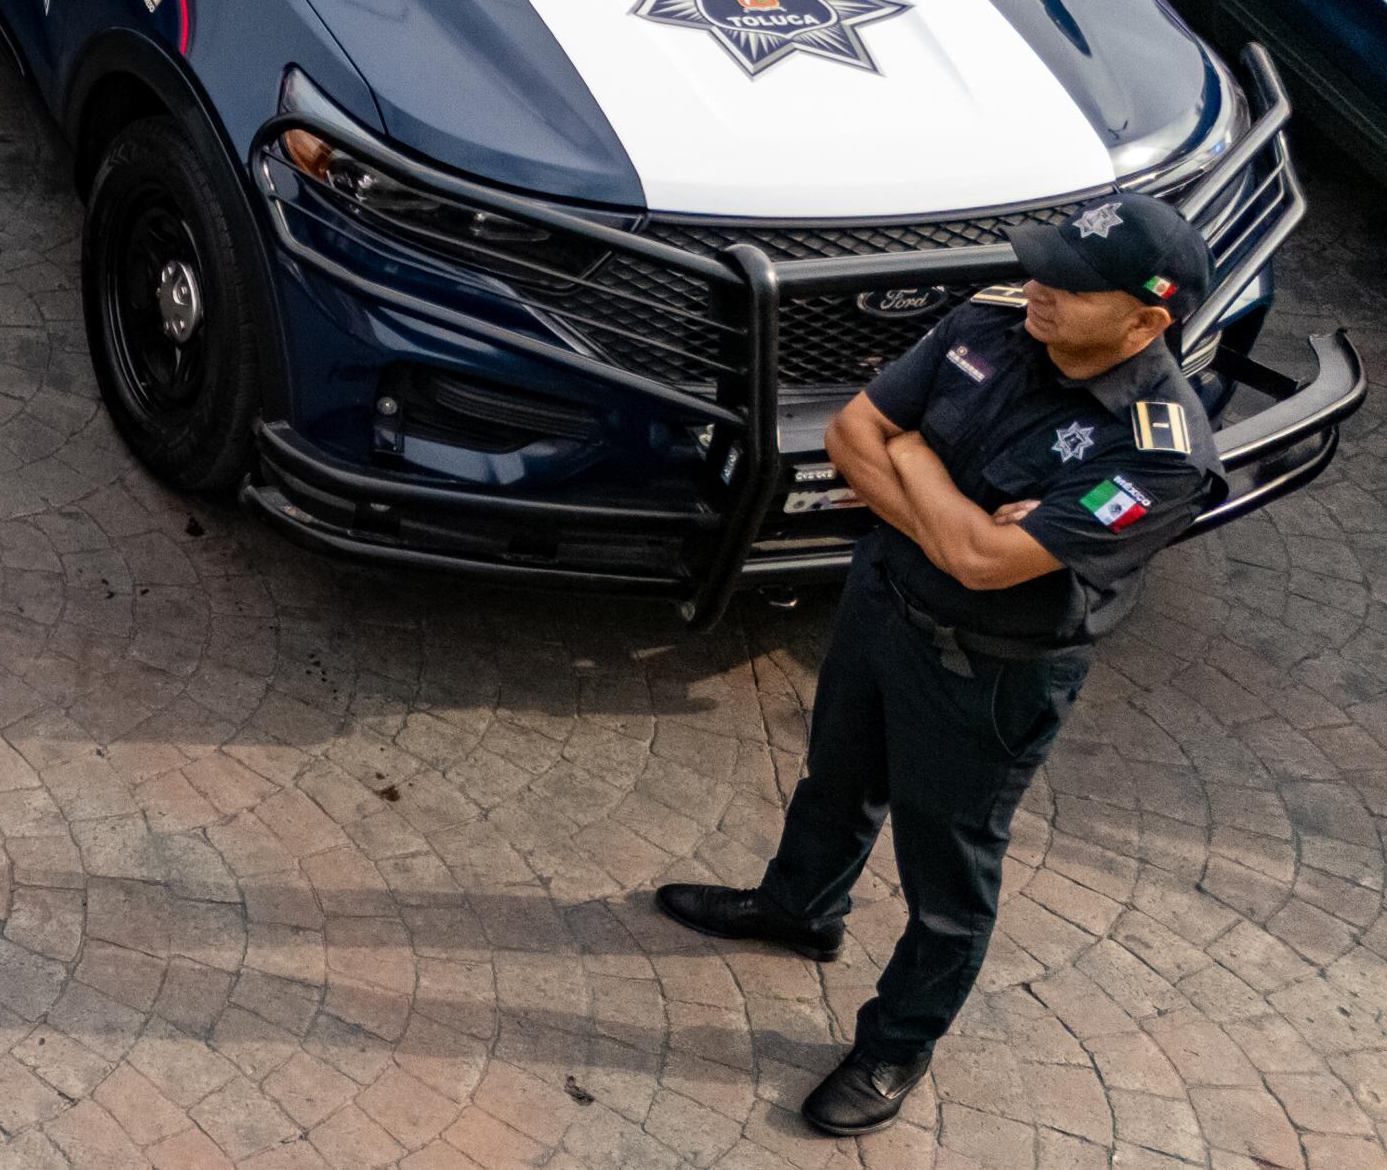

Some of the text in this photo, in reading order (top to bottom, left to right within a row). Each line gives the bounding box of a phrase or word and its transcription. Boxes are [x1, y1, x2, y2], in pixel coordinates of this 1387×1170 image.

[727, 14, 820, 27] TOLUCA
[880, 288, 929, 310] Ford
[1113, 475, 1151, 507] MÉXICO
